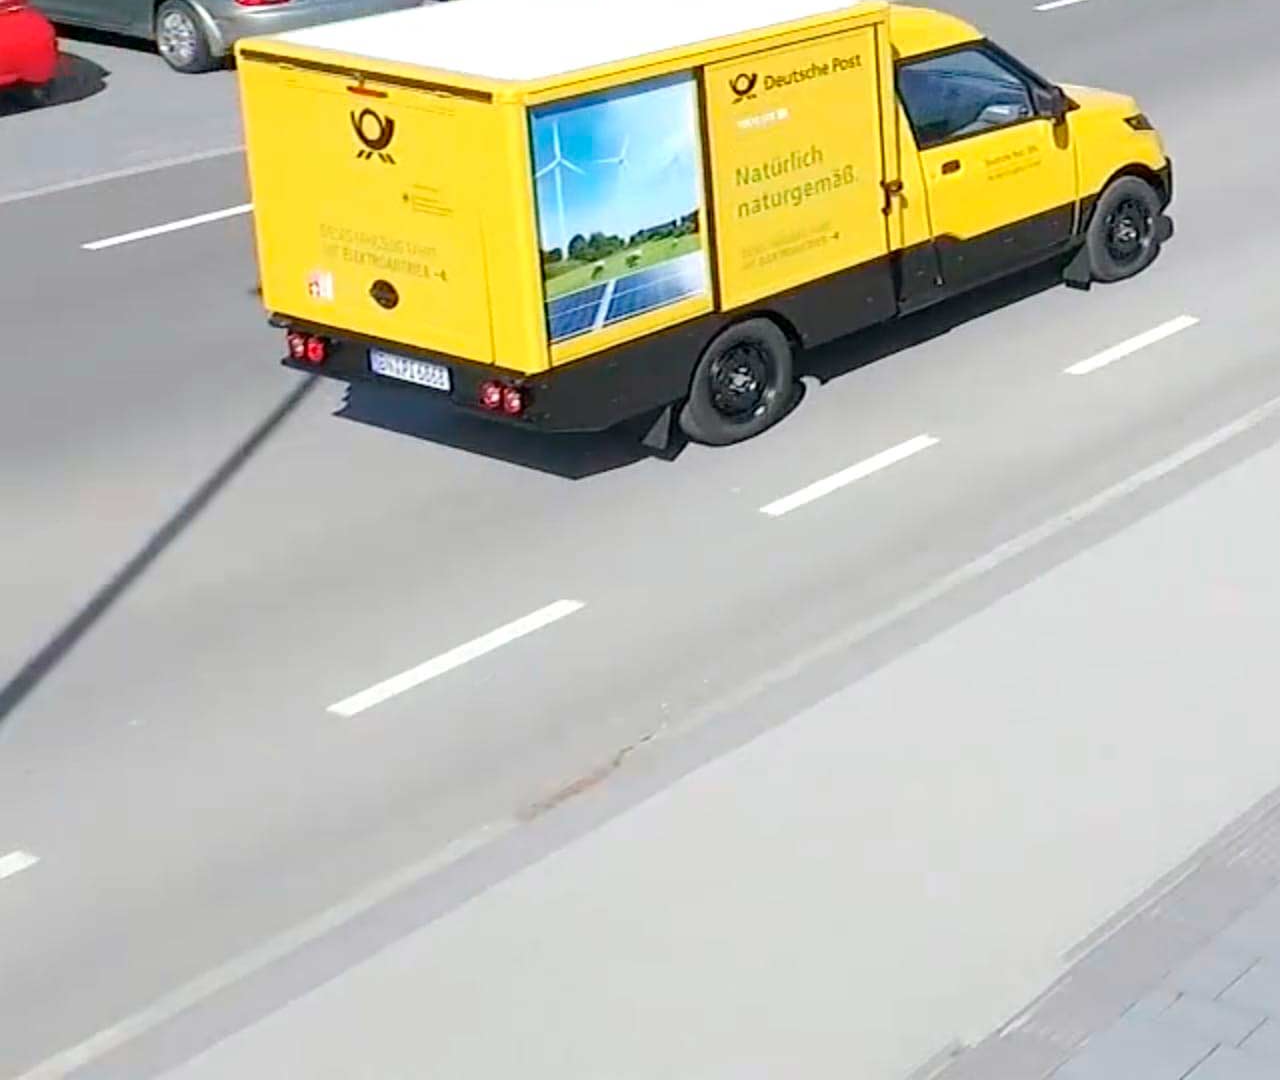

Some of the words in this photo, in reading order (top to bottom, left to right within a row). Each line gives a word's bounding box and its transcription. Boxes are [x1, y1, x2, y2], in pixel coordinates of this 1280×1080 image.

[763, 62, 829, 91] Deutsche
[831, 53, 862, 73] Post
[735, 143, 824, 187] Natürlich
